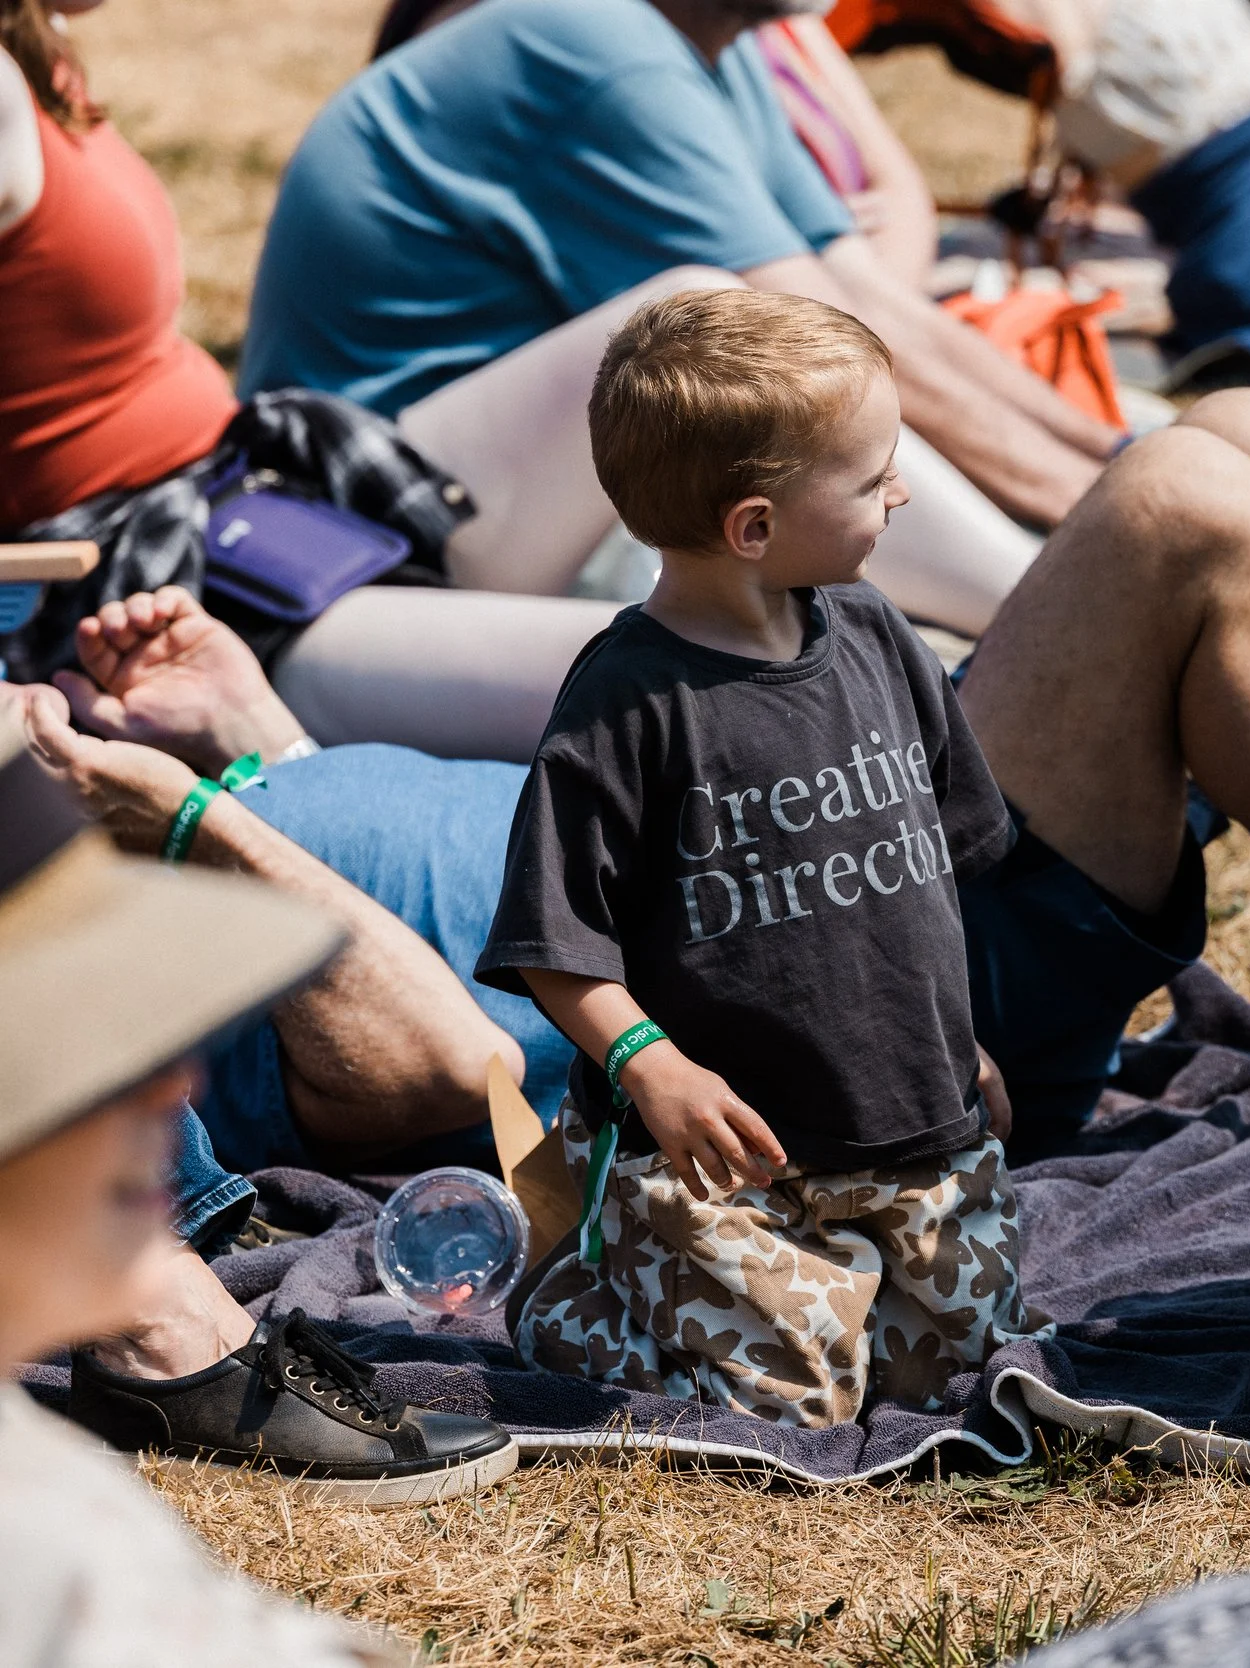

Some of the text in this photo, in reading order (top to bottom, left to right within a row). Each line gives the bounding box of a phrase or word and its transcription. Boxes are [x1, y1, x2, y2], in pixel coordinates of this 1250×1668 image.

[676, 730, 933, 861] Creative
[608, 1024, 663, 1083] Music Festiv
